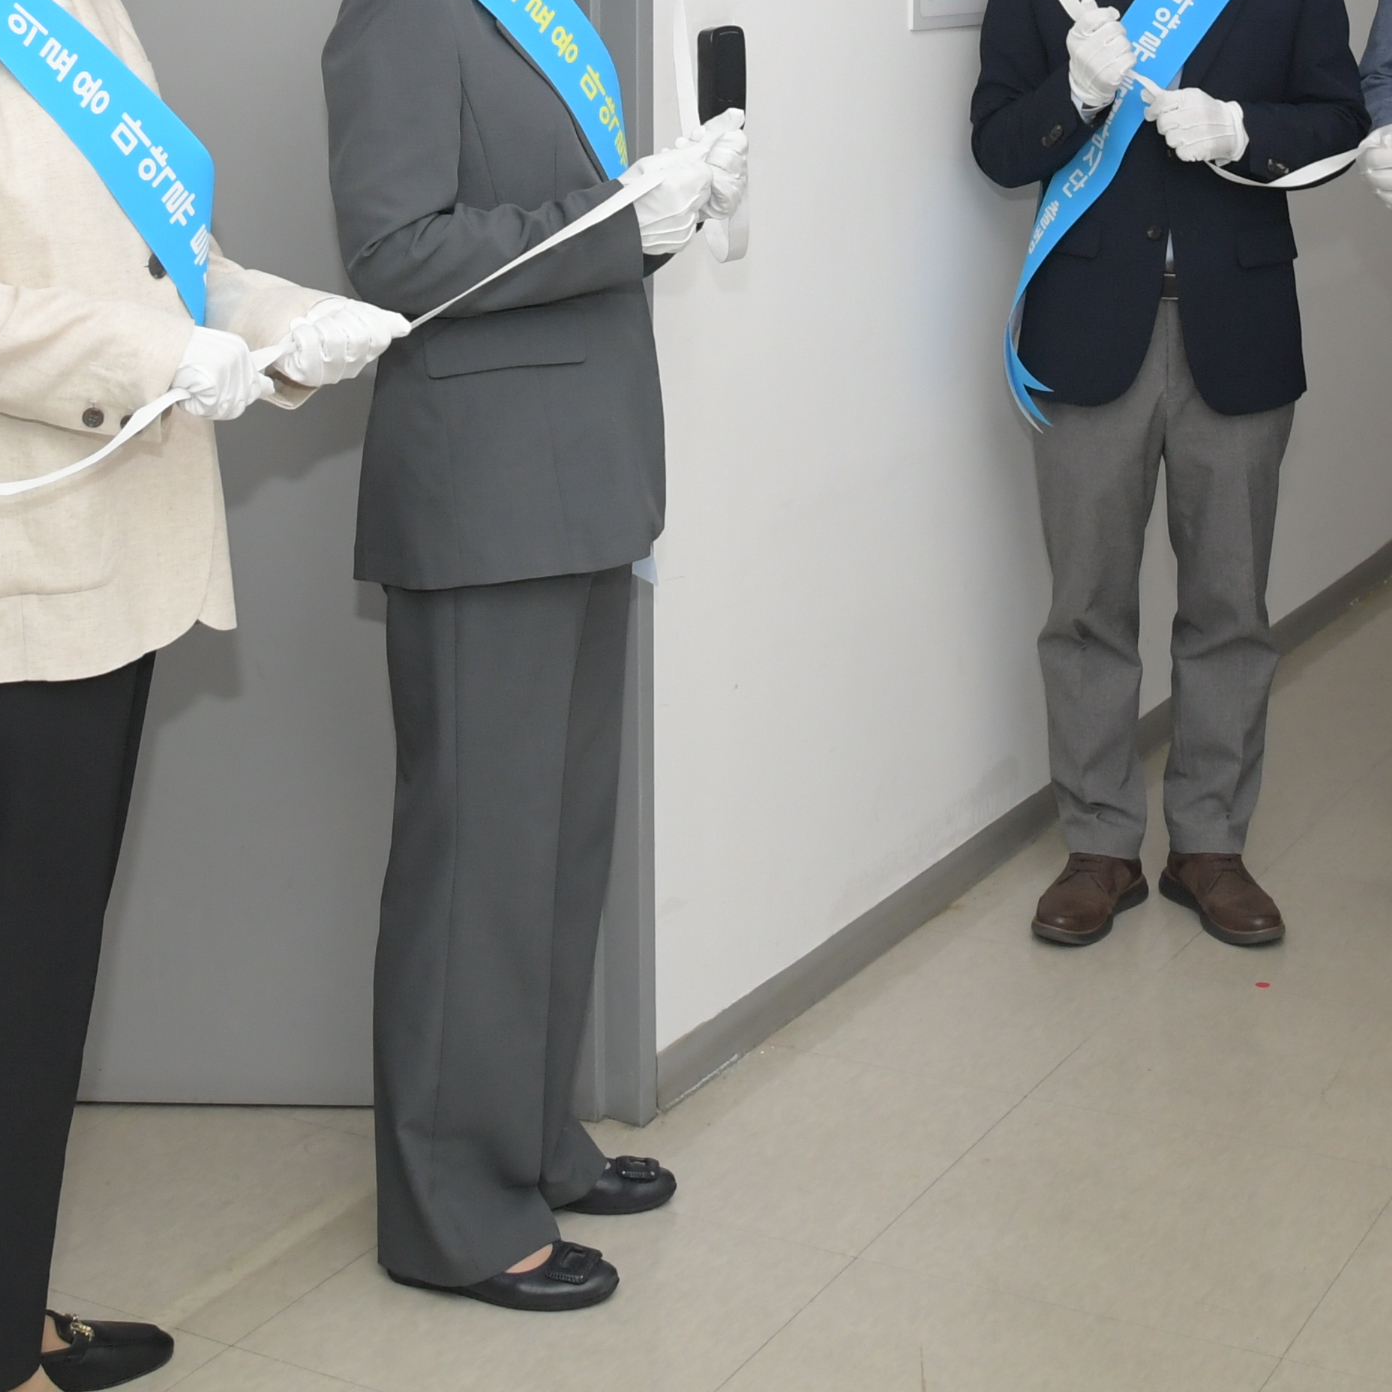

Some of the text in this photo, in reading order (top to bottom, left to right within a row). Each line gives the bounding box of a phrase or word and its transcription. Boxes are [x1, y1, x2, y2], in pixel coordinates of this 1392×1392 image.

[8, 3, 196, 227] 의료용 마약류
[580, 64, 628, 168] 마약류
